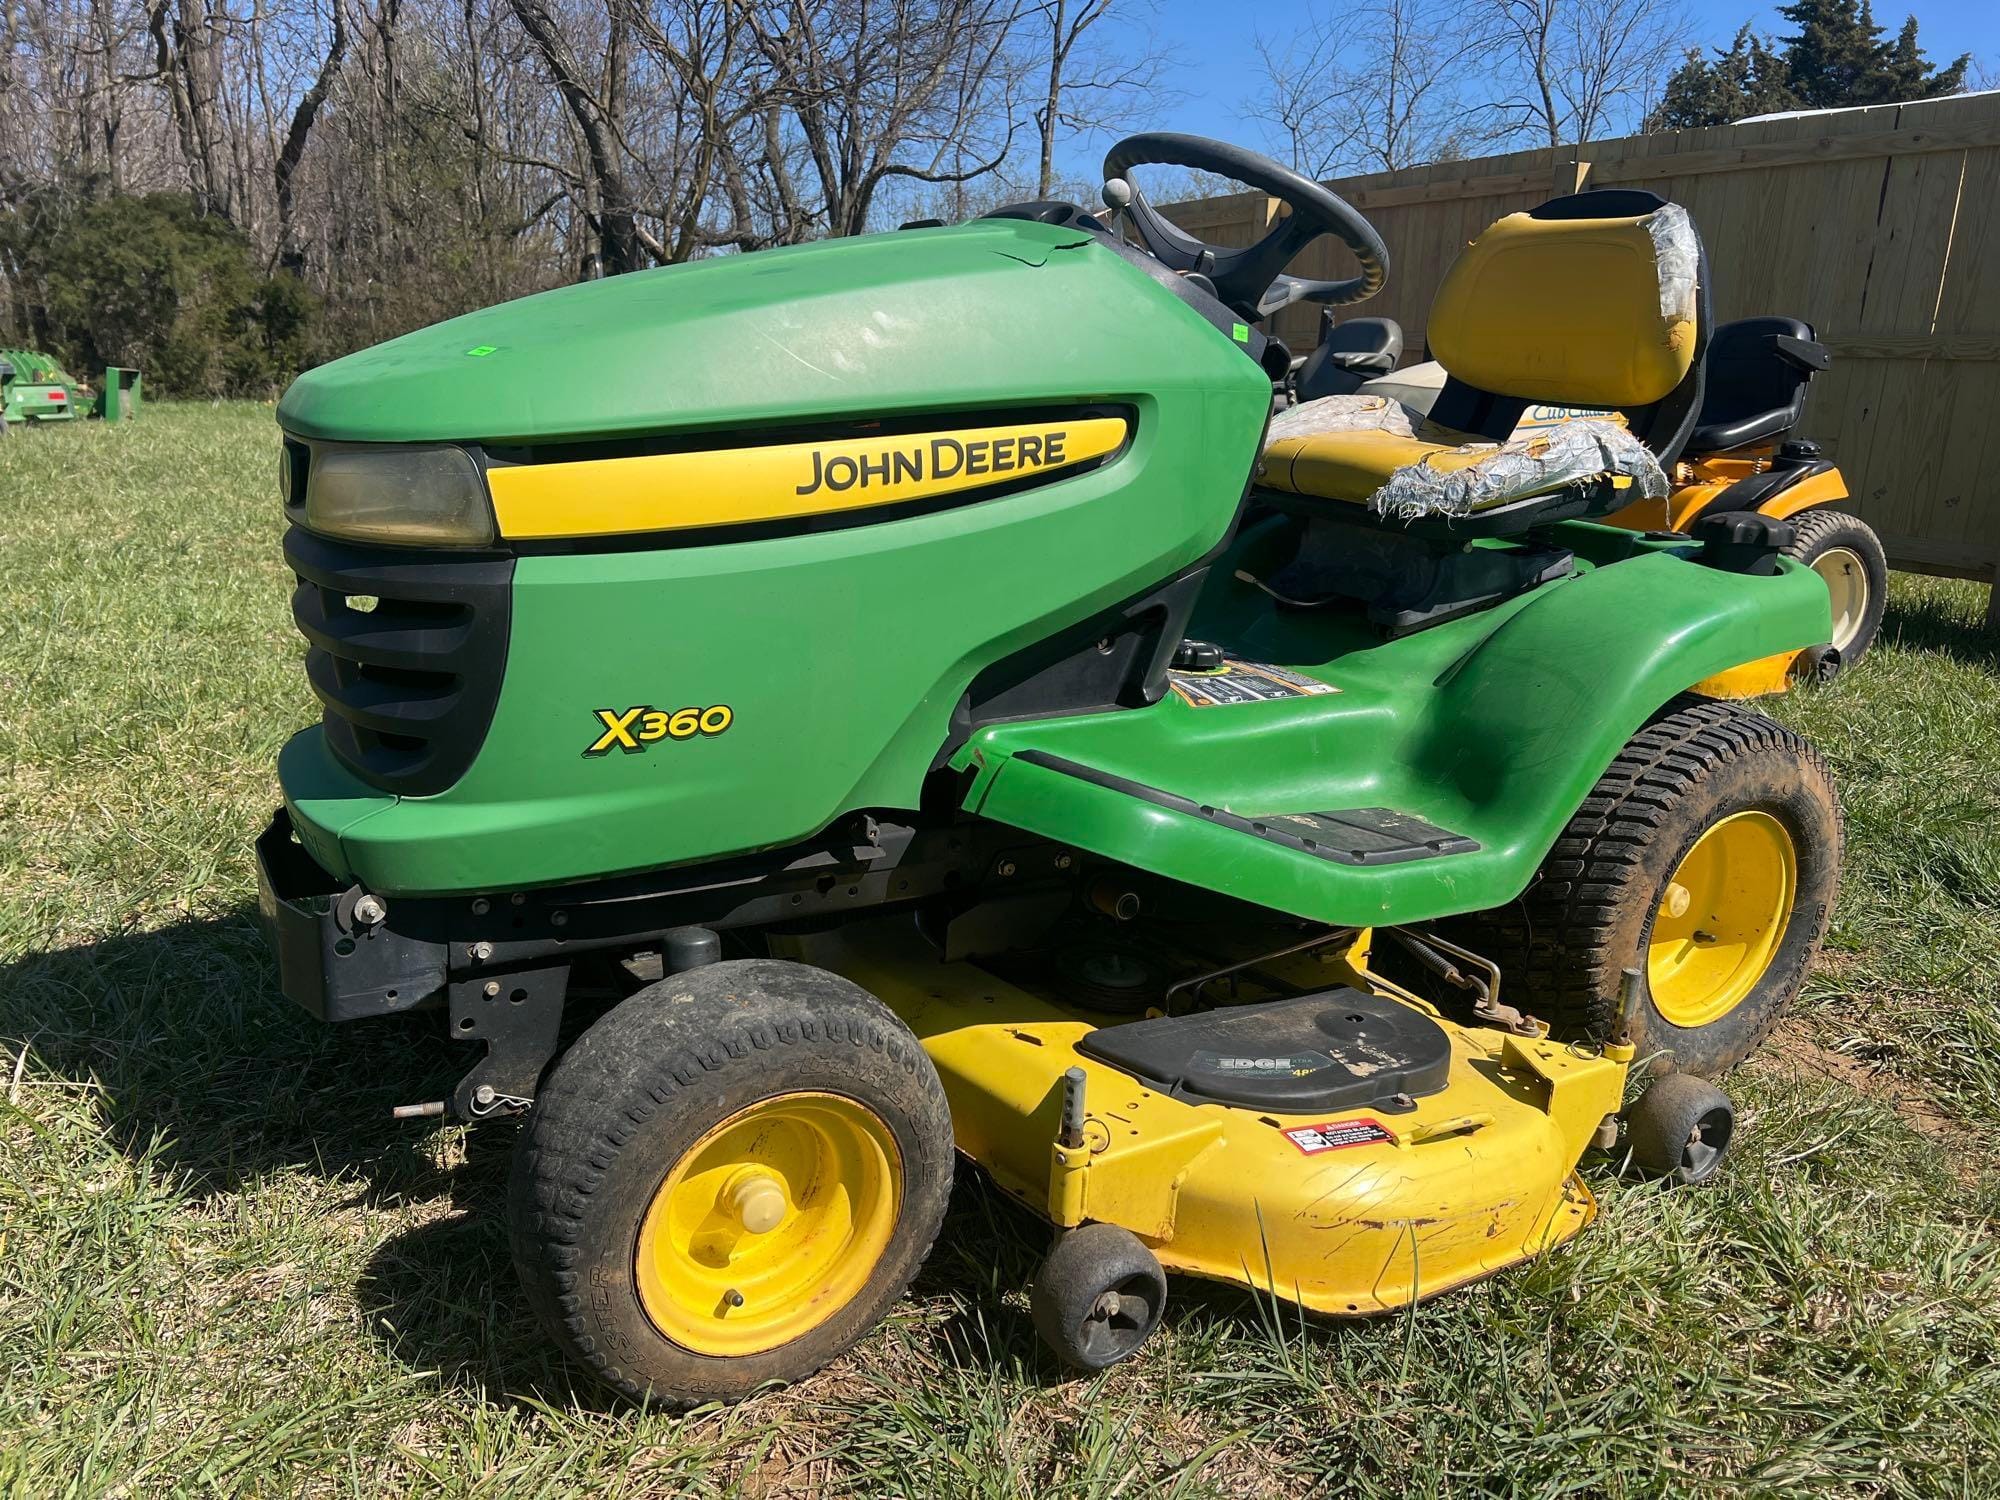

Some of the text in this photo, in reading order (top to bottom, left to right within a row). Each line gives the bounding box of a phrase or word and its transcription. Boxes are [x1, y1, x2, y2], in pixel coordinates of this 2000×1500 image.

[796, 432, 1067, 496] JOHN DEERE
[581, 704, 734, 758] X360
